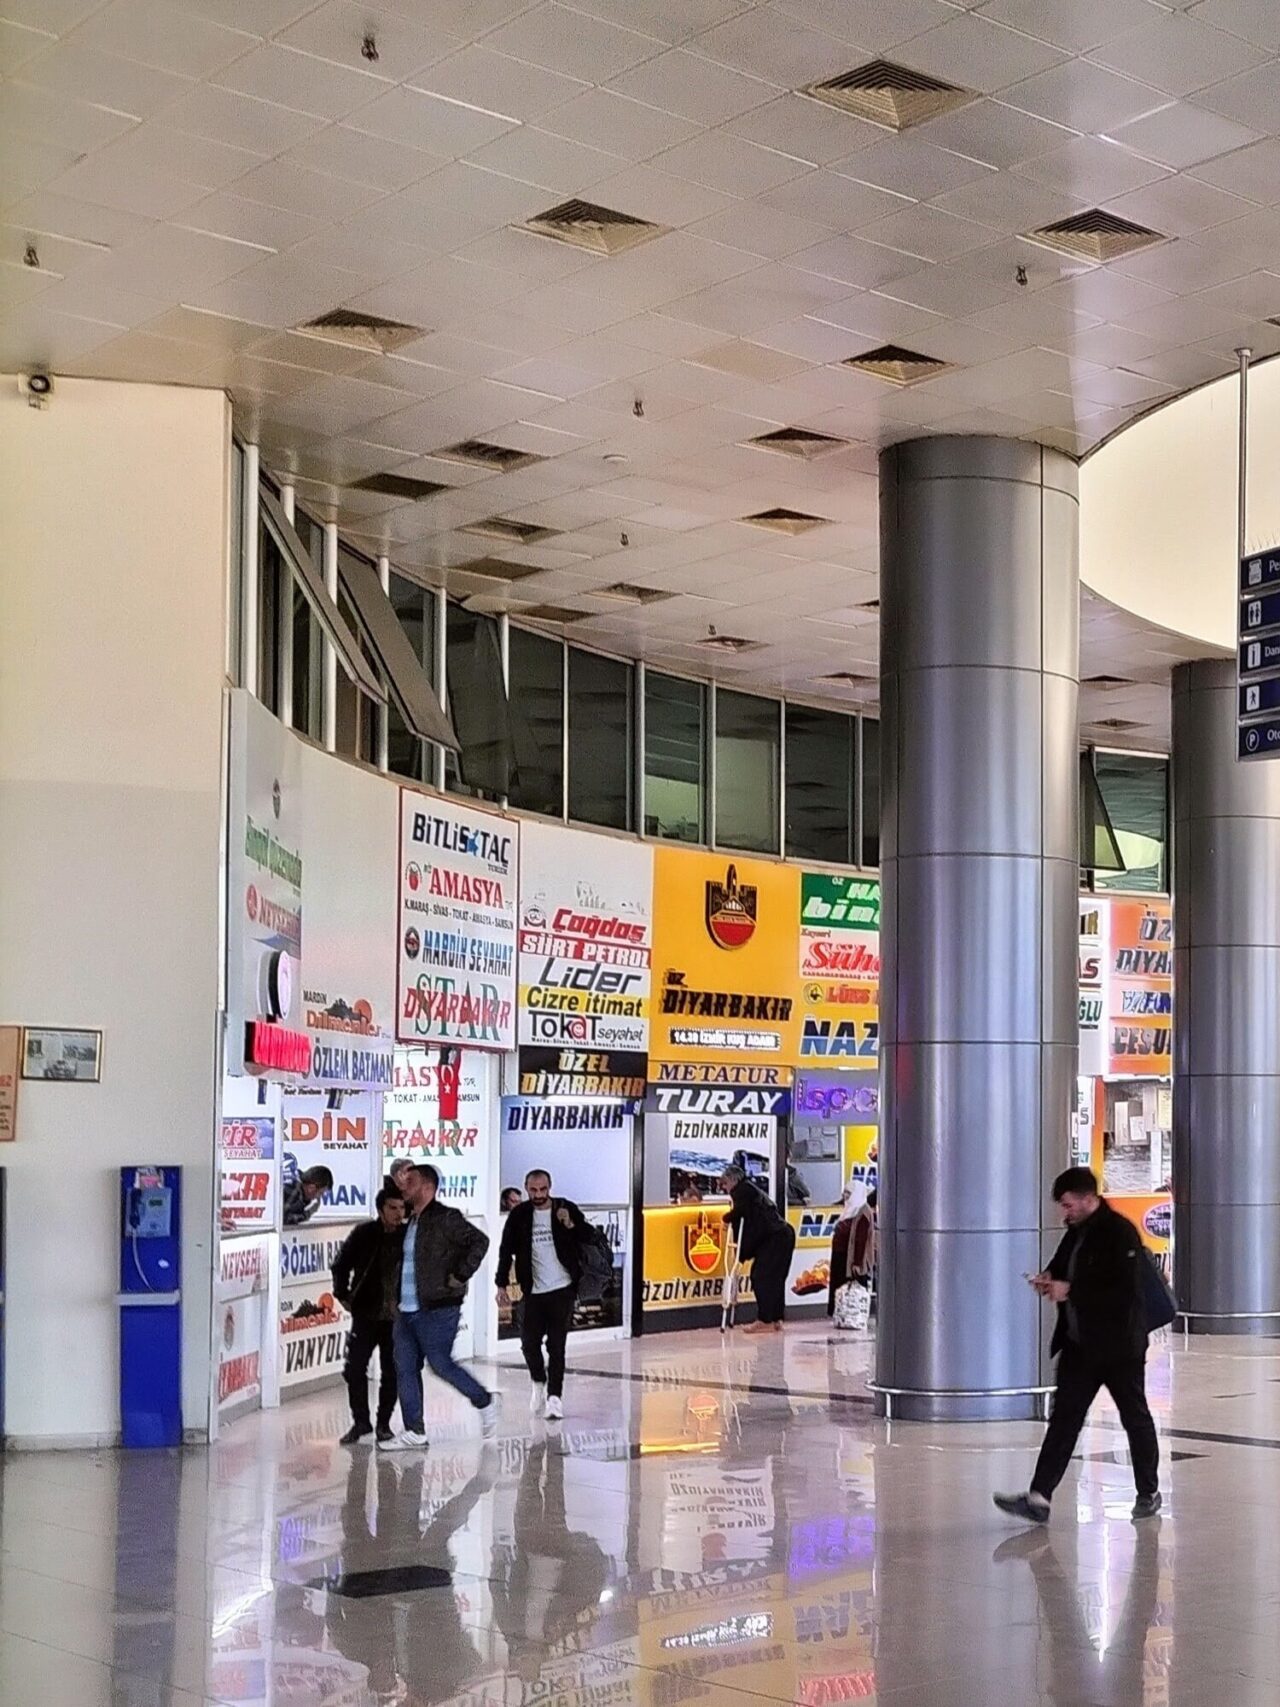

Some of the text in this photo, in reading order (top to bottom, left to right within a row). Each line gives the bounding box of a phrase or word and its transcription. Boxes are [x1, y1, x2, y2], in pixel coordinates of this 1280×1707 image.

[429, 867, 504, 909] AMASYA
[582, 943, 649, 968] PETROL
[538, 957, 643, 994] Lider
[526, 986, 643, 1017] Cizre itimat
[313, 1036, 349, 1079] ÖZLEM
[351, 1048, 394, 1084] BATMAN
[559, 1048, 610, 1073] ÖZEL
[521, 1069, 645, 1097] DİYARBAKIR
[657, 1063, 779, 1085] METATUR
[394, 1093, 418, 1103] TOKAT
[656, 1088, 783, 1113] TURAY
[508, 1101, 624, 1131] DİYARBAKIR
[673, 1119, 769, 1139] ÖZDİYARBAKIR
[324, 1142, 369, 1150] SEYAHAT
[290, 1236, 325, 1277] ÖZLEM
